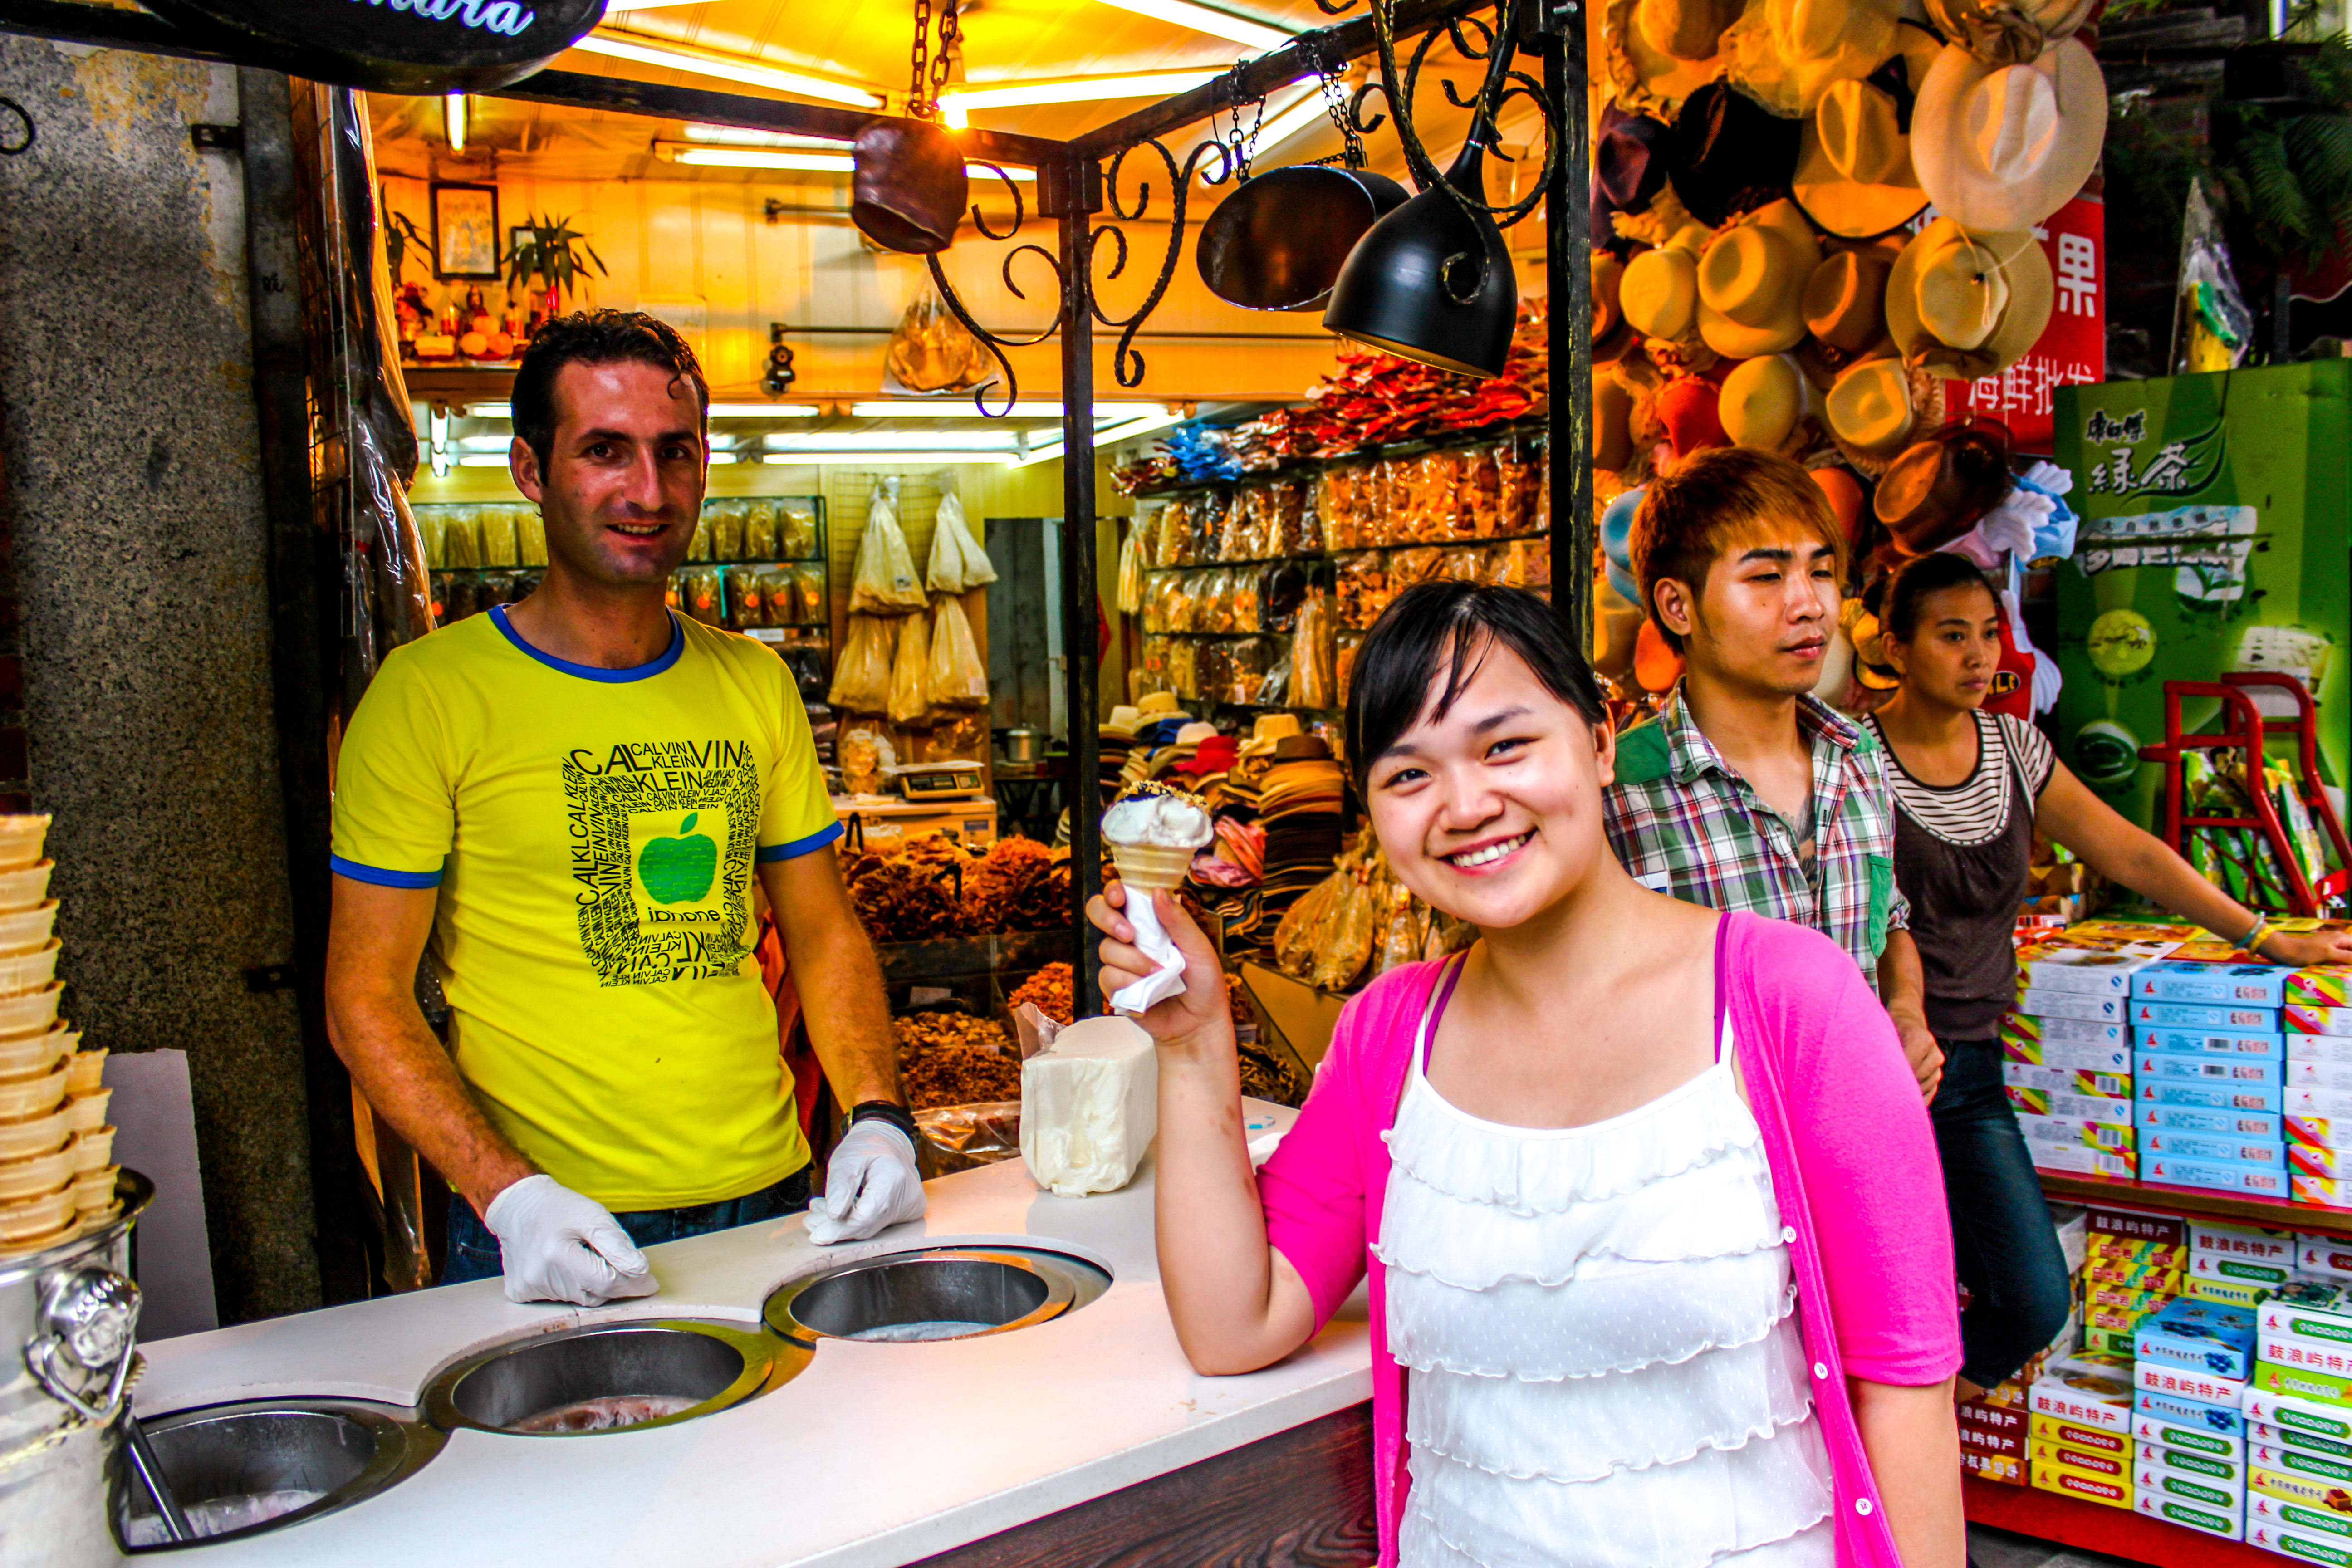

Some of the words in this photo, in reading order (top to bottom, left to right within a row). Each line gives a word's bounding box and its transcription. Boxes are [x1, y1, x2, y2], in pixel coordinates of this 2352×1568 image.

[631, 742, 687, 756] CALVIN
[652, 755, 696, 769] KLEIN
[562, 757, 579, 800] KLEIN
[632, 771, 703, 793] KLEIN
[647, 791, 676, 801] CALVIN
[678, 790, 700, 798] KLEIN
[2145, 1372, 2232, 1399] 鼓浪屿特产
[2037, 1396, 2117, 1424] 鼓浪屿特产
